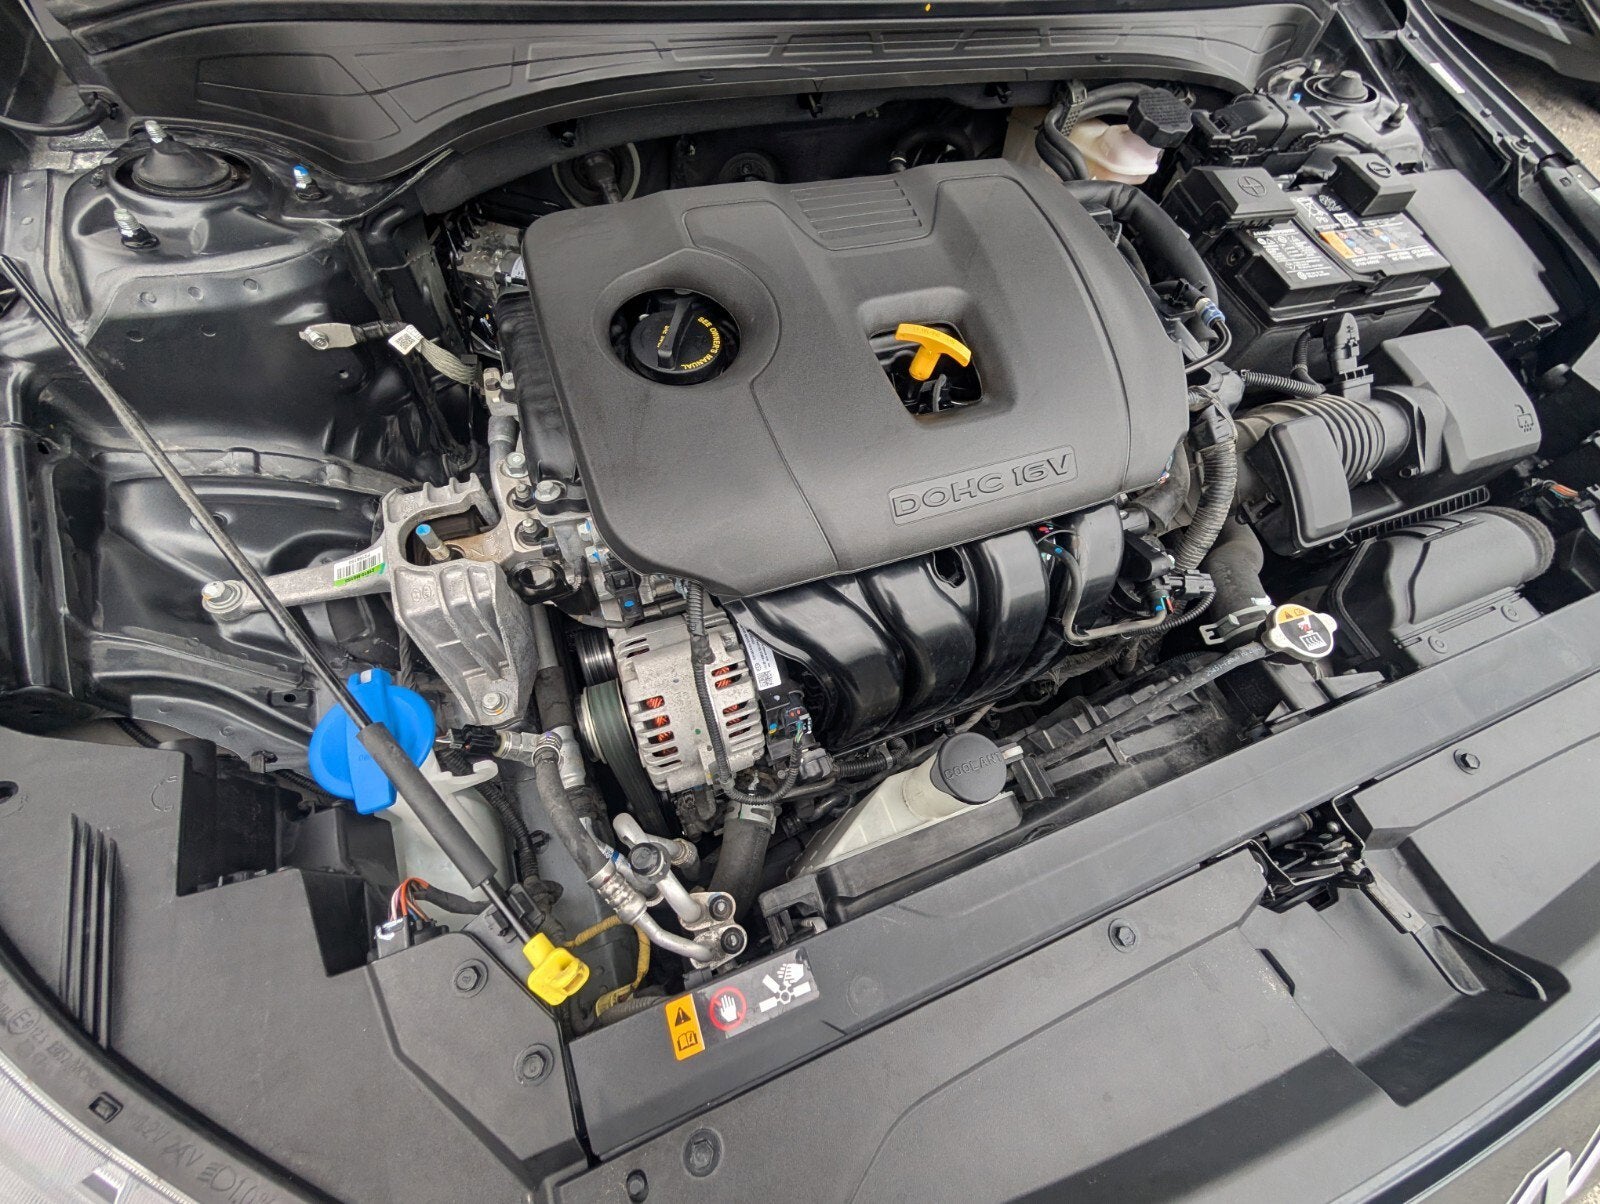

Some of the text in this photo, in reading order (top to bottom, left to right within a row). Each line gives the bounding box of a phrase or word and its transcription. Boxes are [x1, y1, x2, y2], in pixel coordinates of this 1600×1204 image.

[680, 316, 721, 370] SEE OWNER'S MANUAL
[892, 453, 1073, 518] DOHC 16V
[943, 751, 1002, 781] COOLANT
